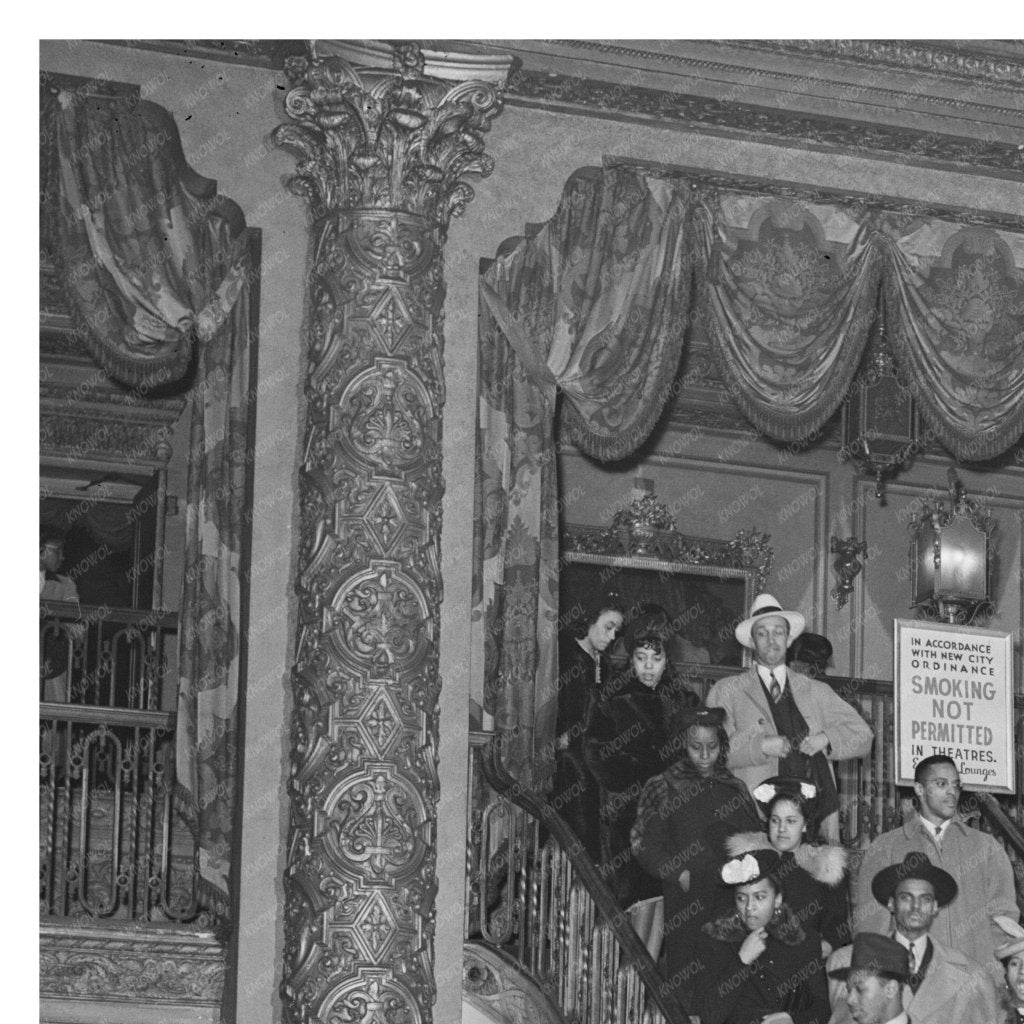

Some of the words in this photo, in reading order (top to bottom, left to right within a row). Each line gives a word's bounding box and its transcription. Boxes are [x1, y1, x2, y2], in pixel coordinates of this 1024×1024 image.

[911, 637, 921, 646] IN
[926, 639, 991, 653] ACCORDANCE
[911, 649, 937, 658] WITH
[941, 652, 963, 661] NEW
[968, 655, 993, 664] CITY
[911, 660, 995, 676] ORDINANCE
[911, 675, 996, 701] SMOKING
[932, 699, 974, 721] NOT
[911, 720, 993, 746] PERMITTED
[911, 744, 923, 756] IN
[931, 746, 997, 763] THEATRES.
[959, 761, 997, 782] Lounges
